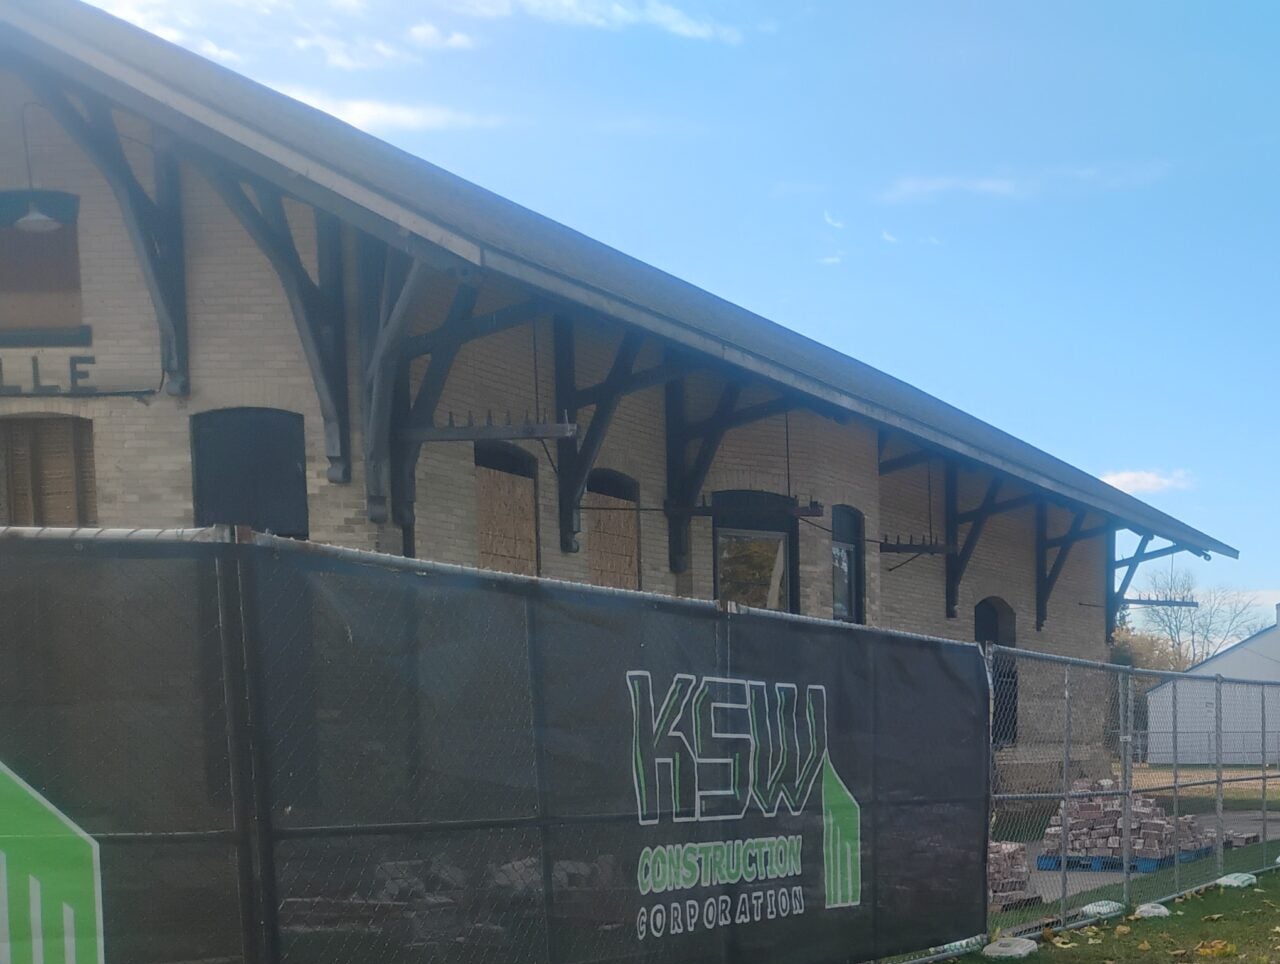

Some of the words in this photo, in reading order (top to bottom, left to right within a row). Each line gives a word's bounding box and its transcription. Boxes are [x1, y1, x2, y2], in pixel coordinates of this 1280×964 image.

[626, 670, 827, 825] KSW
[637, 835, 803, 895] CONSTRUCTION
[636, 886, 805, 940] CORPORATION
